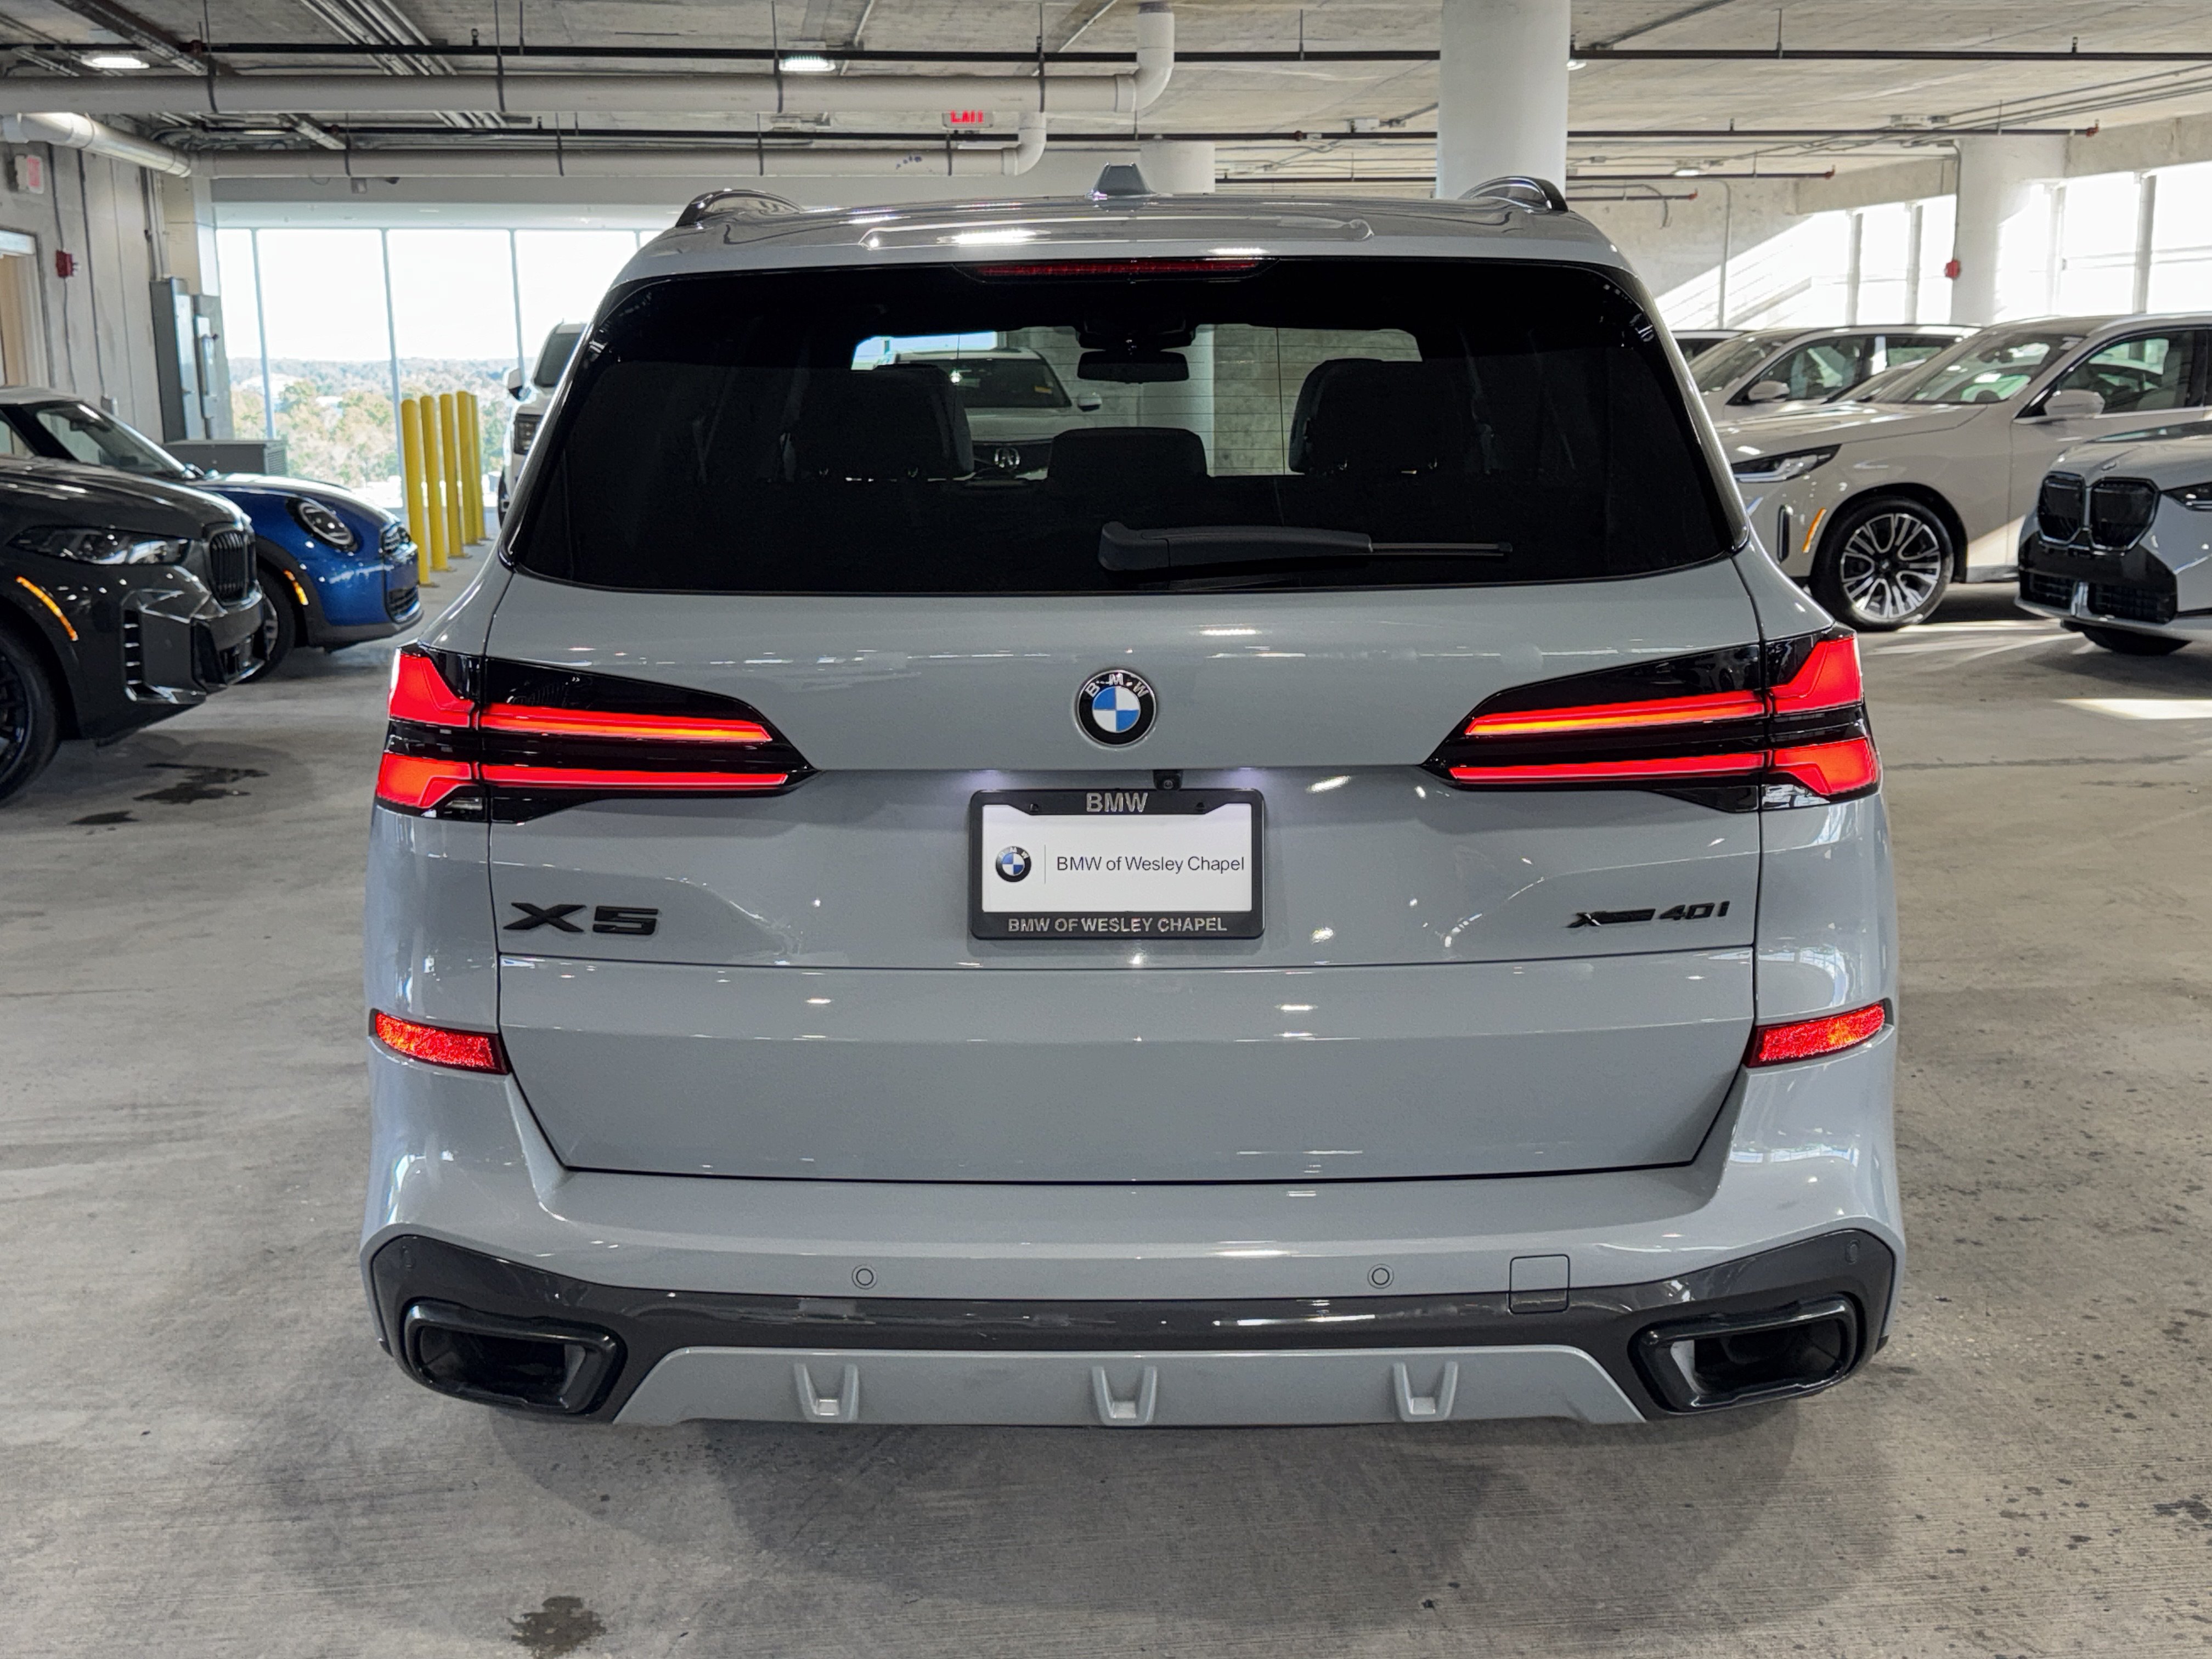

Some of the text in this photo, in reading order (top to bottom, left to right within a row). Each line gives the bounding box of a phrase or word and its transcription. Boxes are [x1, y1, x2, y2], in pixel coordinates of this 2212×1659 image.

[1085, 672, 1149, 698] BMW
[1086, 792, 1148, 812] BMW
[1057, 856, 1244, 874] BMW of Wesley Chapel
[503, 902, 659, 935] X5
[1008, 917, 1228, 932] BMW OF WESLEY CHAPEL
